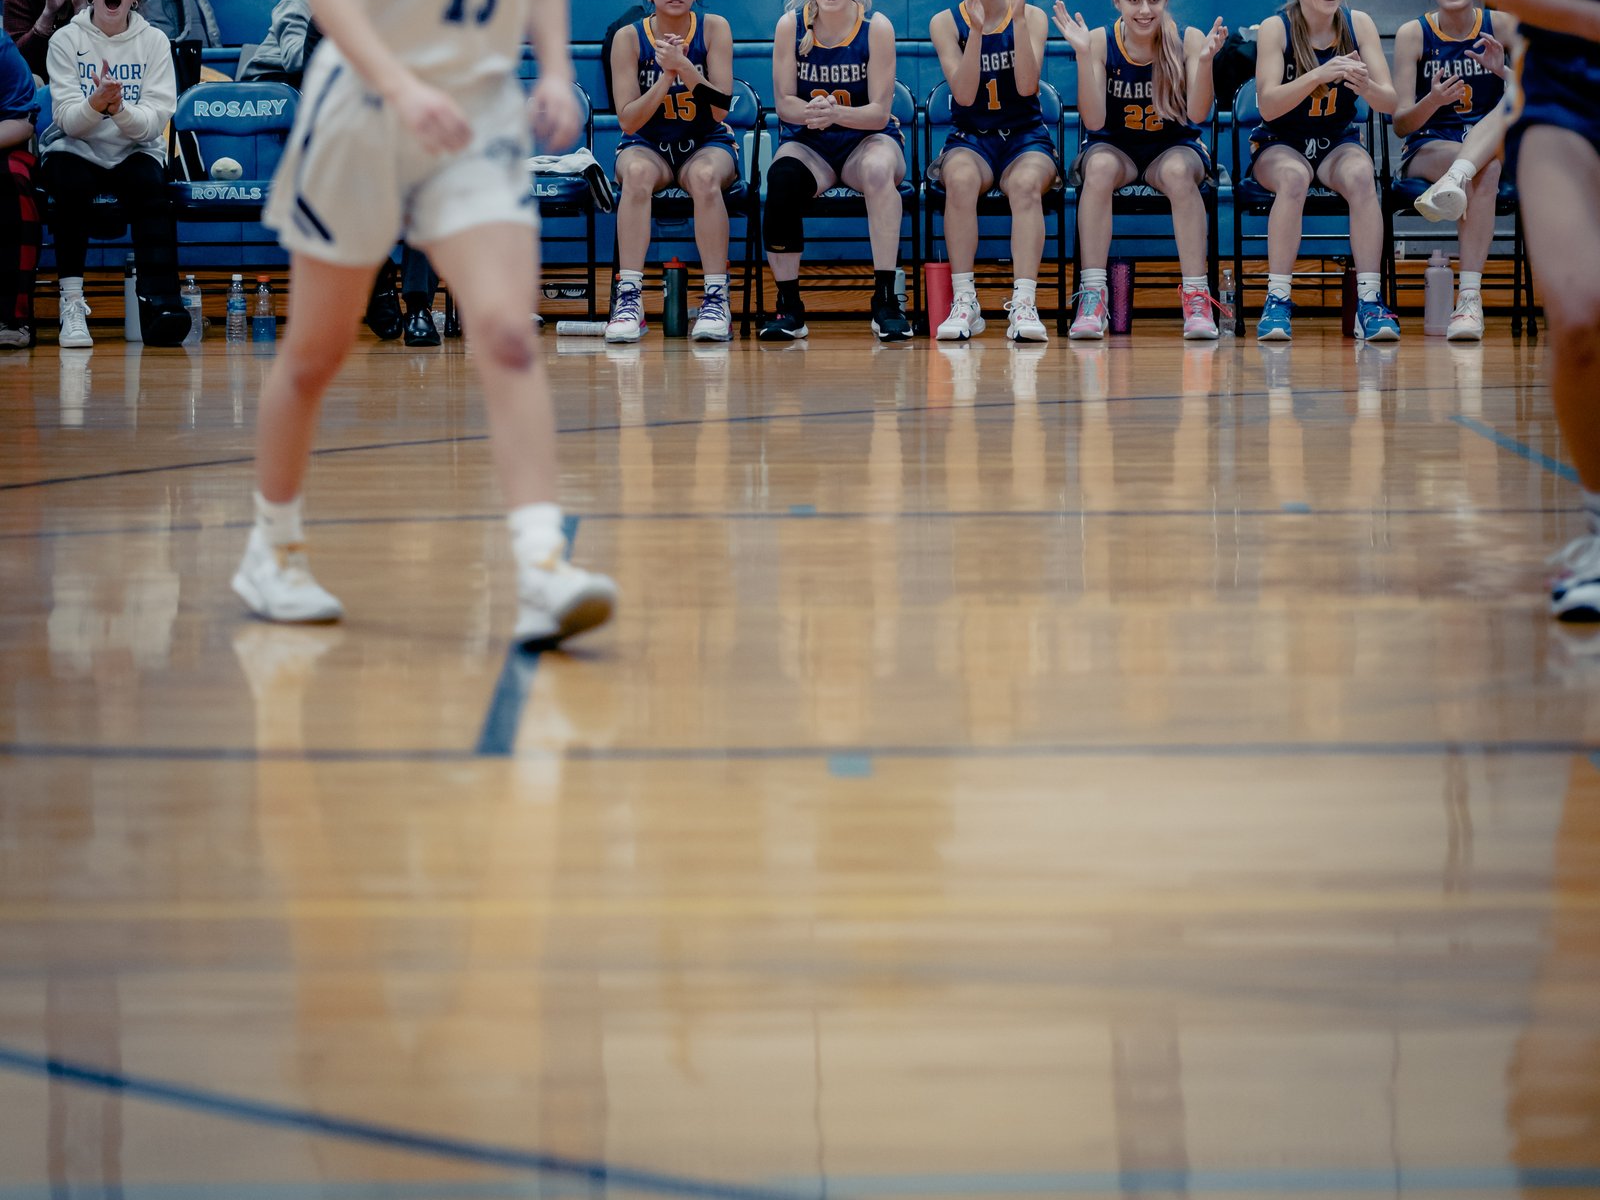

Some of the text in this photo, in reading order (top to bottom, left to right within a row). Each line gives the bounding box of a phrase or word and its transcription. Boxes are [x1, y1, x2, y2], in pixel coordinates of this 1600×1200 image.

[193, 98, 288, 118] ROSARY
[663, 91, 697, 122] 15
[985, 78, 1002, 110] 1
[1453, 83, 1473, 114] 3
[1123, 104, 1164, 132] 22
[191, 186, 262, 201] ROYALS
